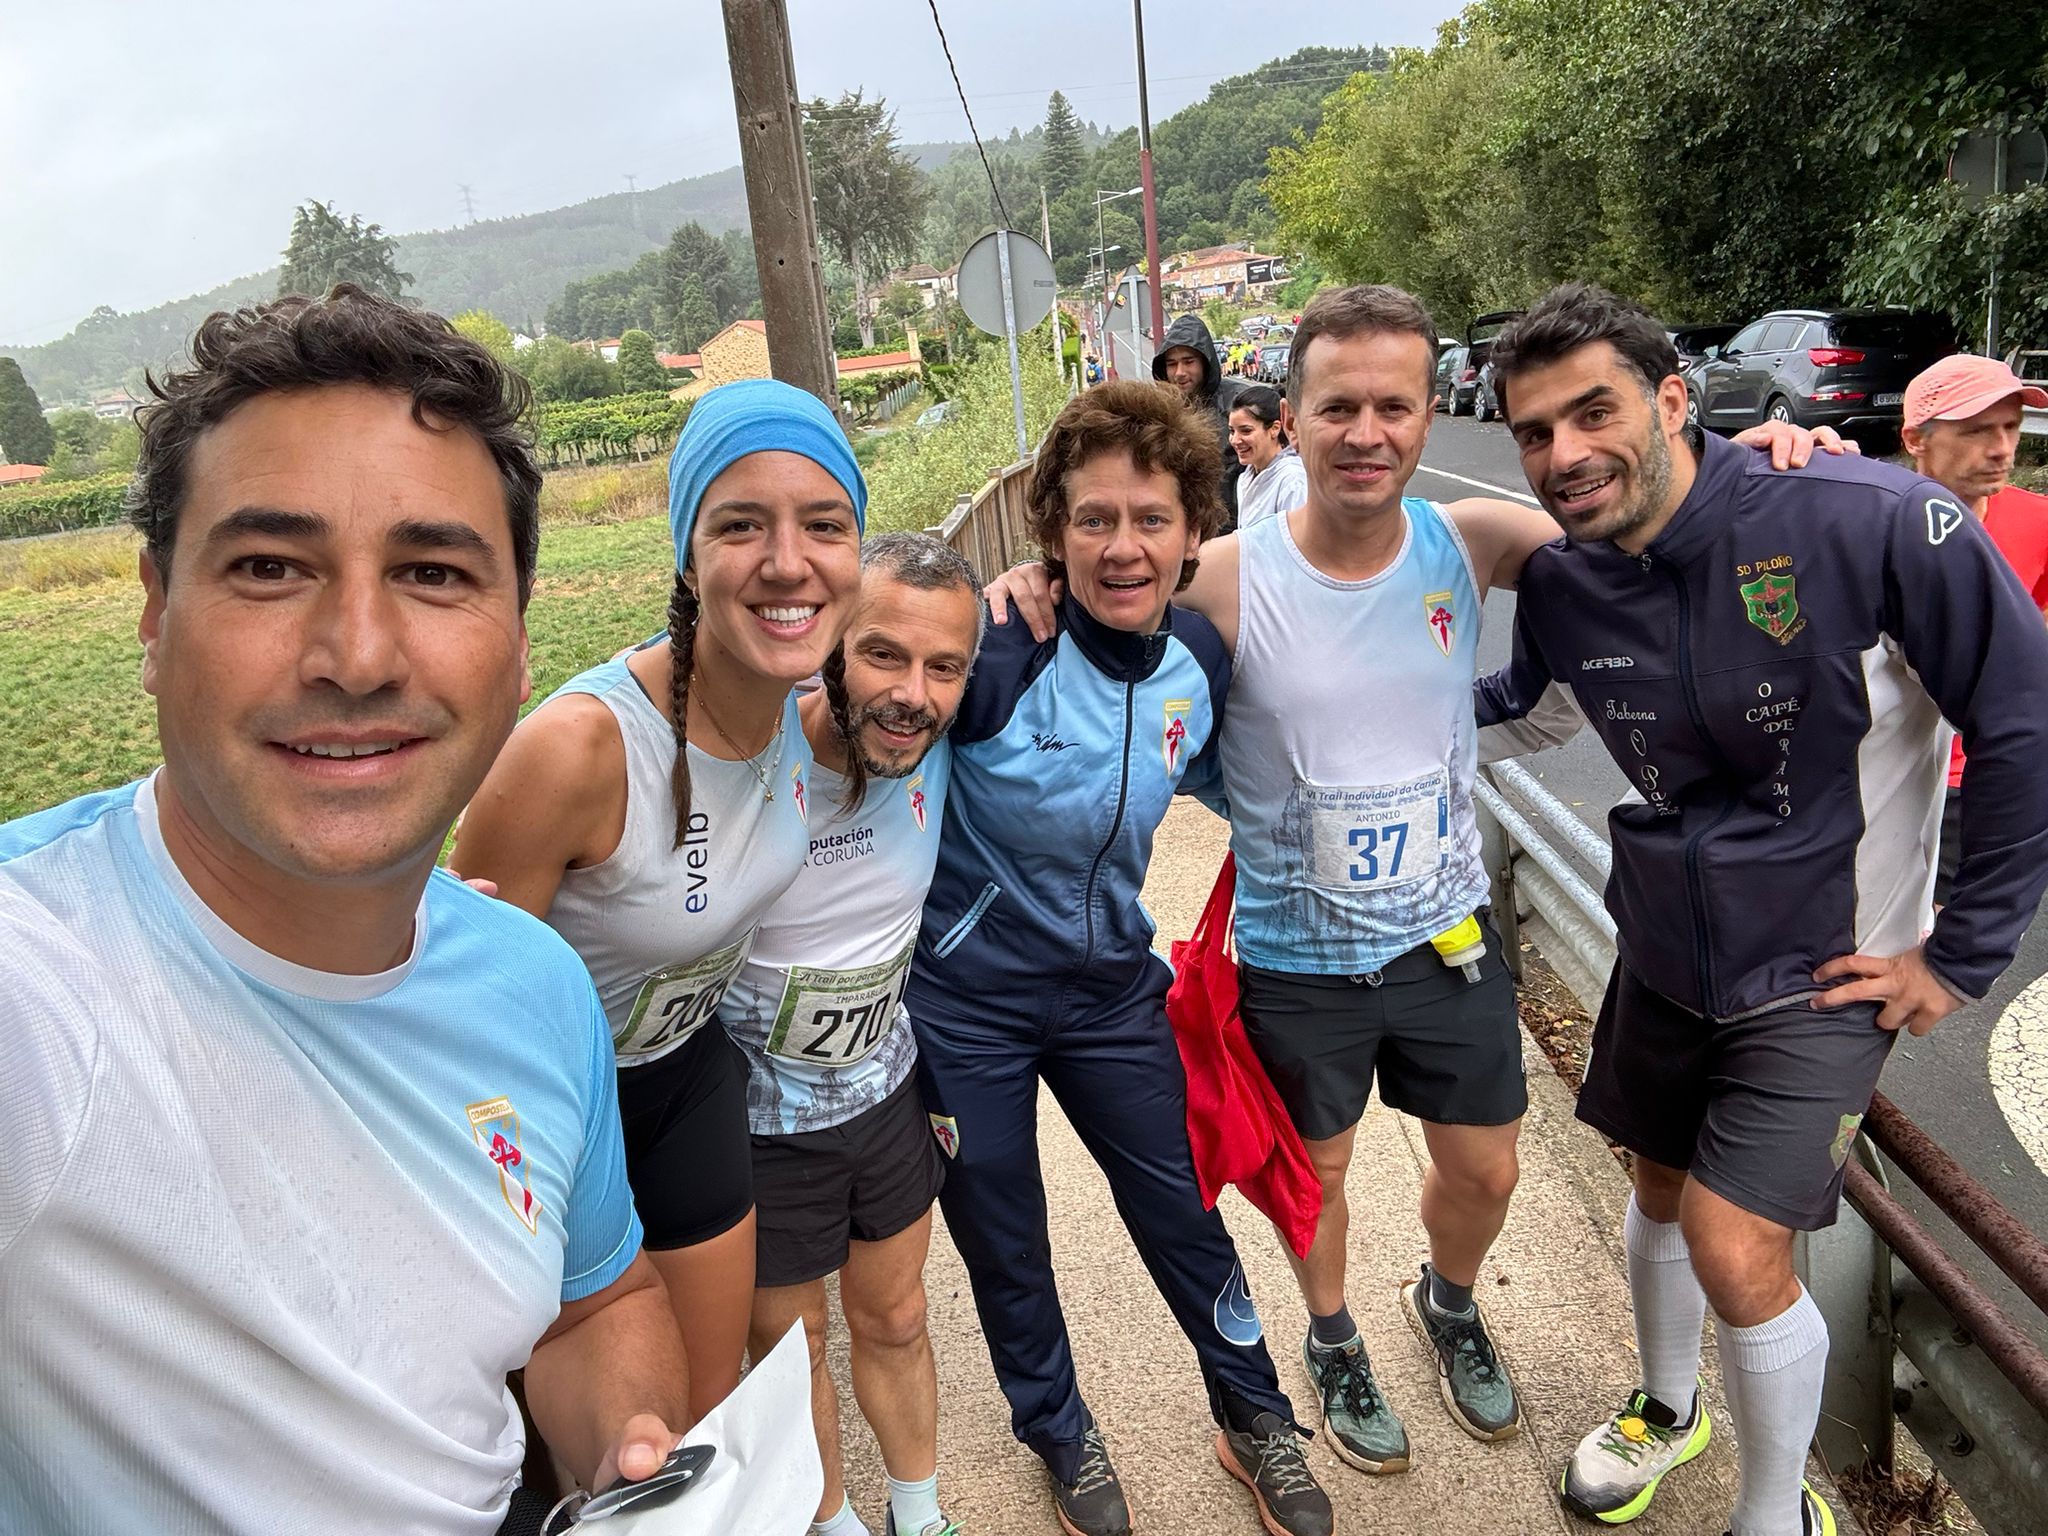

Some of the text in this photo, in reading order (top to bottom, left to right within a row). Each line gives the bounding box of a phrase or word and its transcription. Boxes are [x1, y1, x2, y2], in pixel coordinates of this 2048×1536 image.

[1736, 555, 1793, 577] SD PILOÑO
[1582, 656, 1635, 671] ACERBIS
[1758, 682, 1772, 698] O
[1606, 699, 1657, 721] Taberna
[1746, 696, 1801, 723] CAFÉ
[1763, 718, 1795, 734] DE
[1319, 791, 1343, 802] Trail
[1355, 810, 1401, 823] ANTONIO
[809, 826, 874, 855] putación
[684, 812, 709, 914] evelb
[813, 841, 875, 867] CORUÑA
[1348, 822, 1409, 882] 37
[812, 974, 835, 984] Trail
[837, 975, 856, 986] por
[801, 991, 892, 1058] 270
